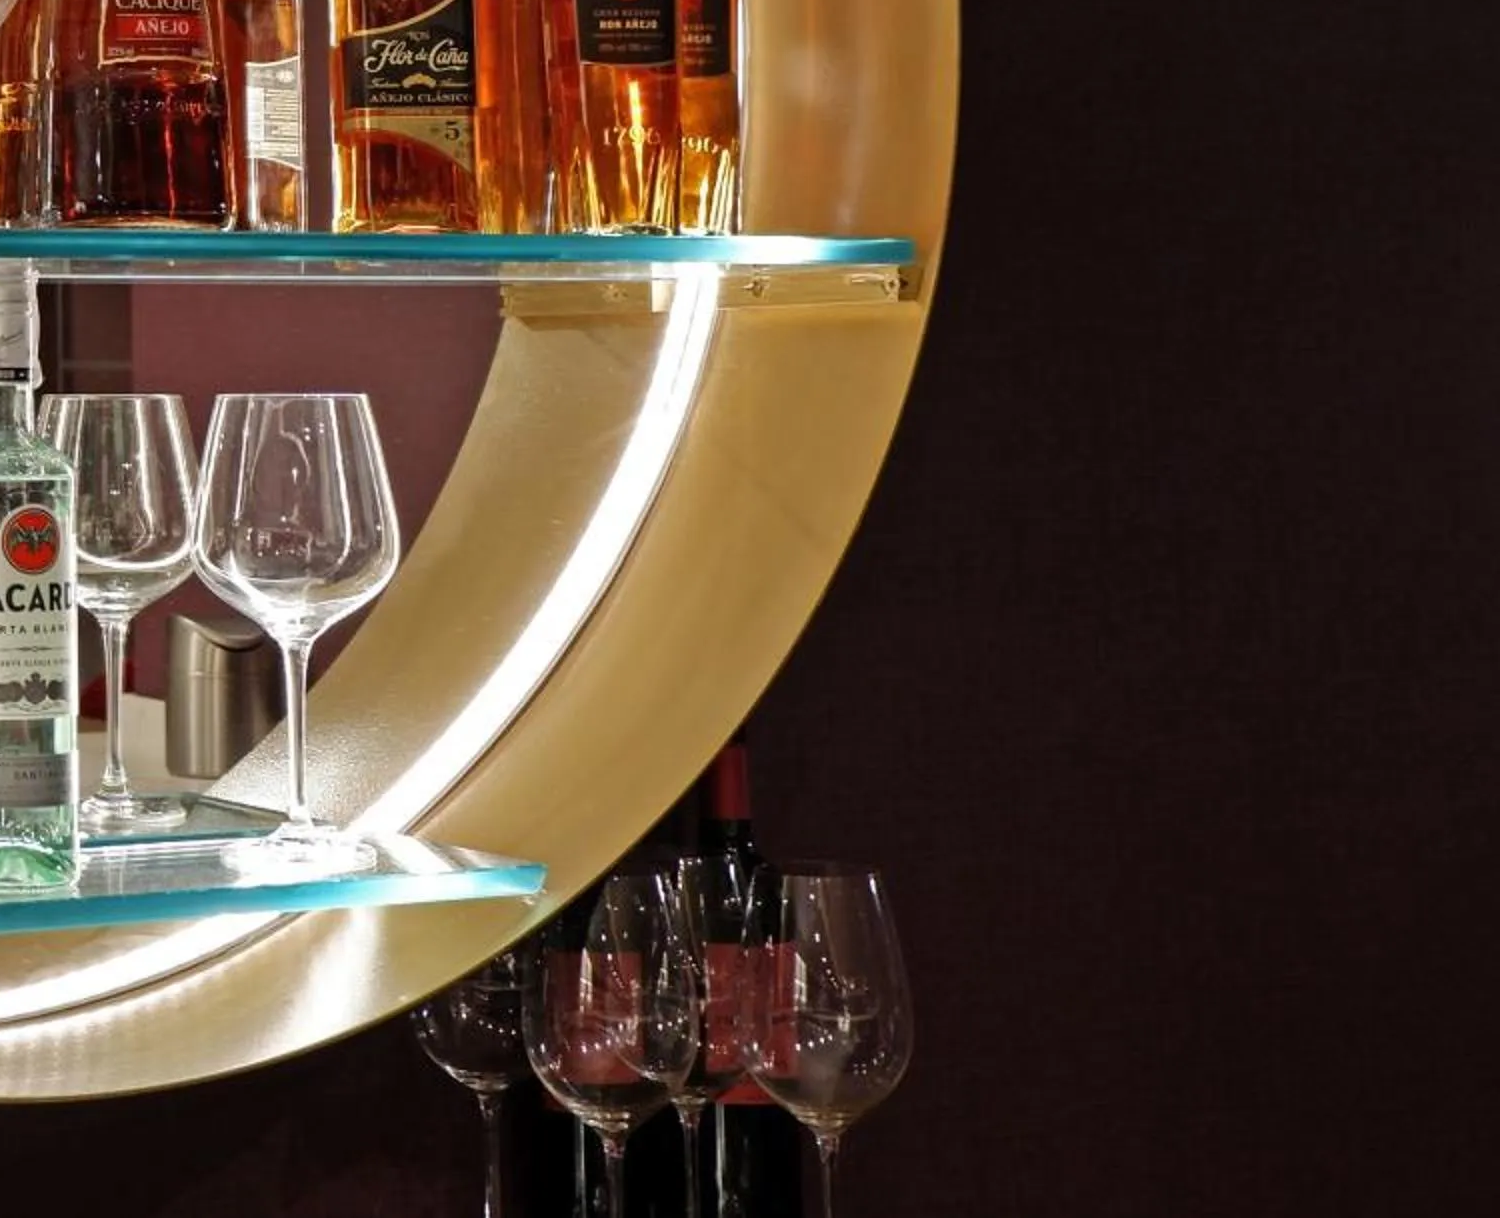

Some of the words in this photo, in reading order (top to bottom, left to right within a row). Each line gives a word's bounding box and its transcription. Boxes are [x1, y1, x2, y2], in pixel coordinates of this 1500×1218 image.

[134, 17, 189, 35] AÑEJO
[363, 39, 416, 74] Flor
[427, 38, 469, 73] Caña
[445, 120, 461, 141] 5
